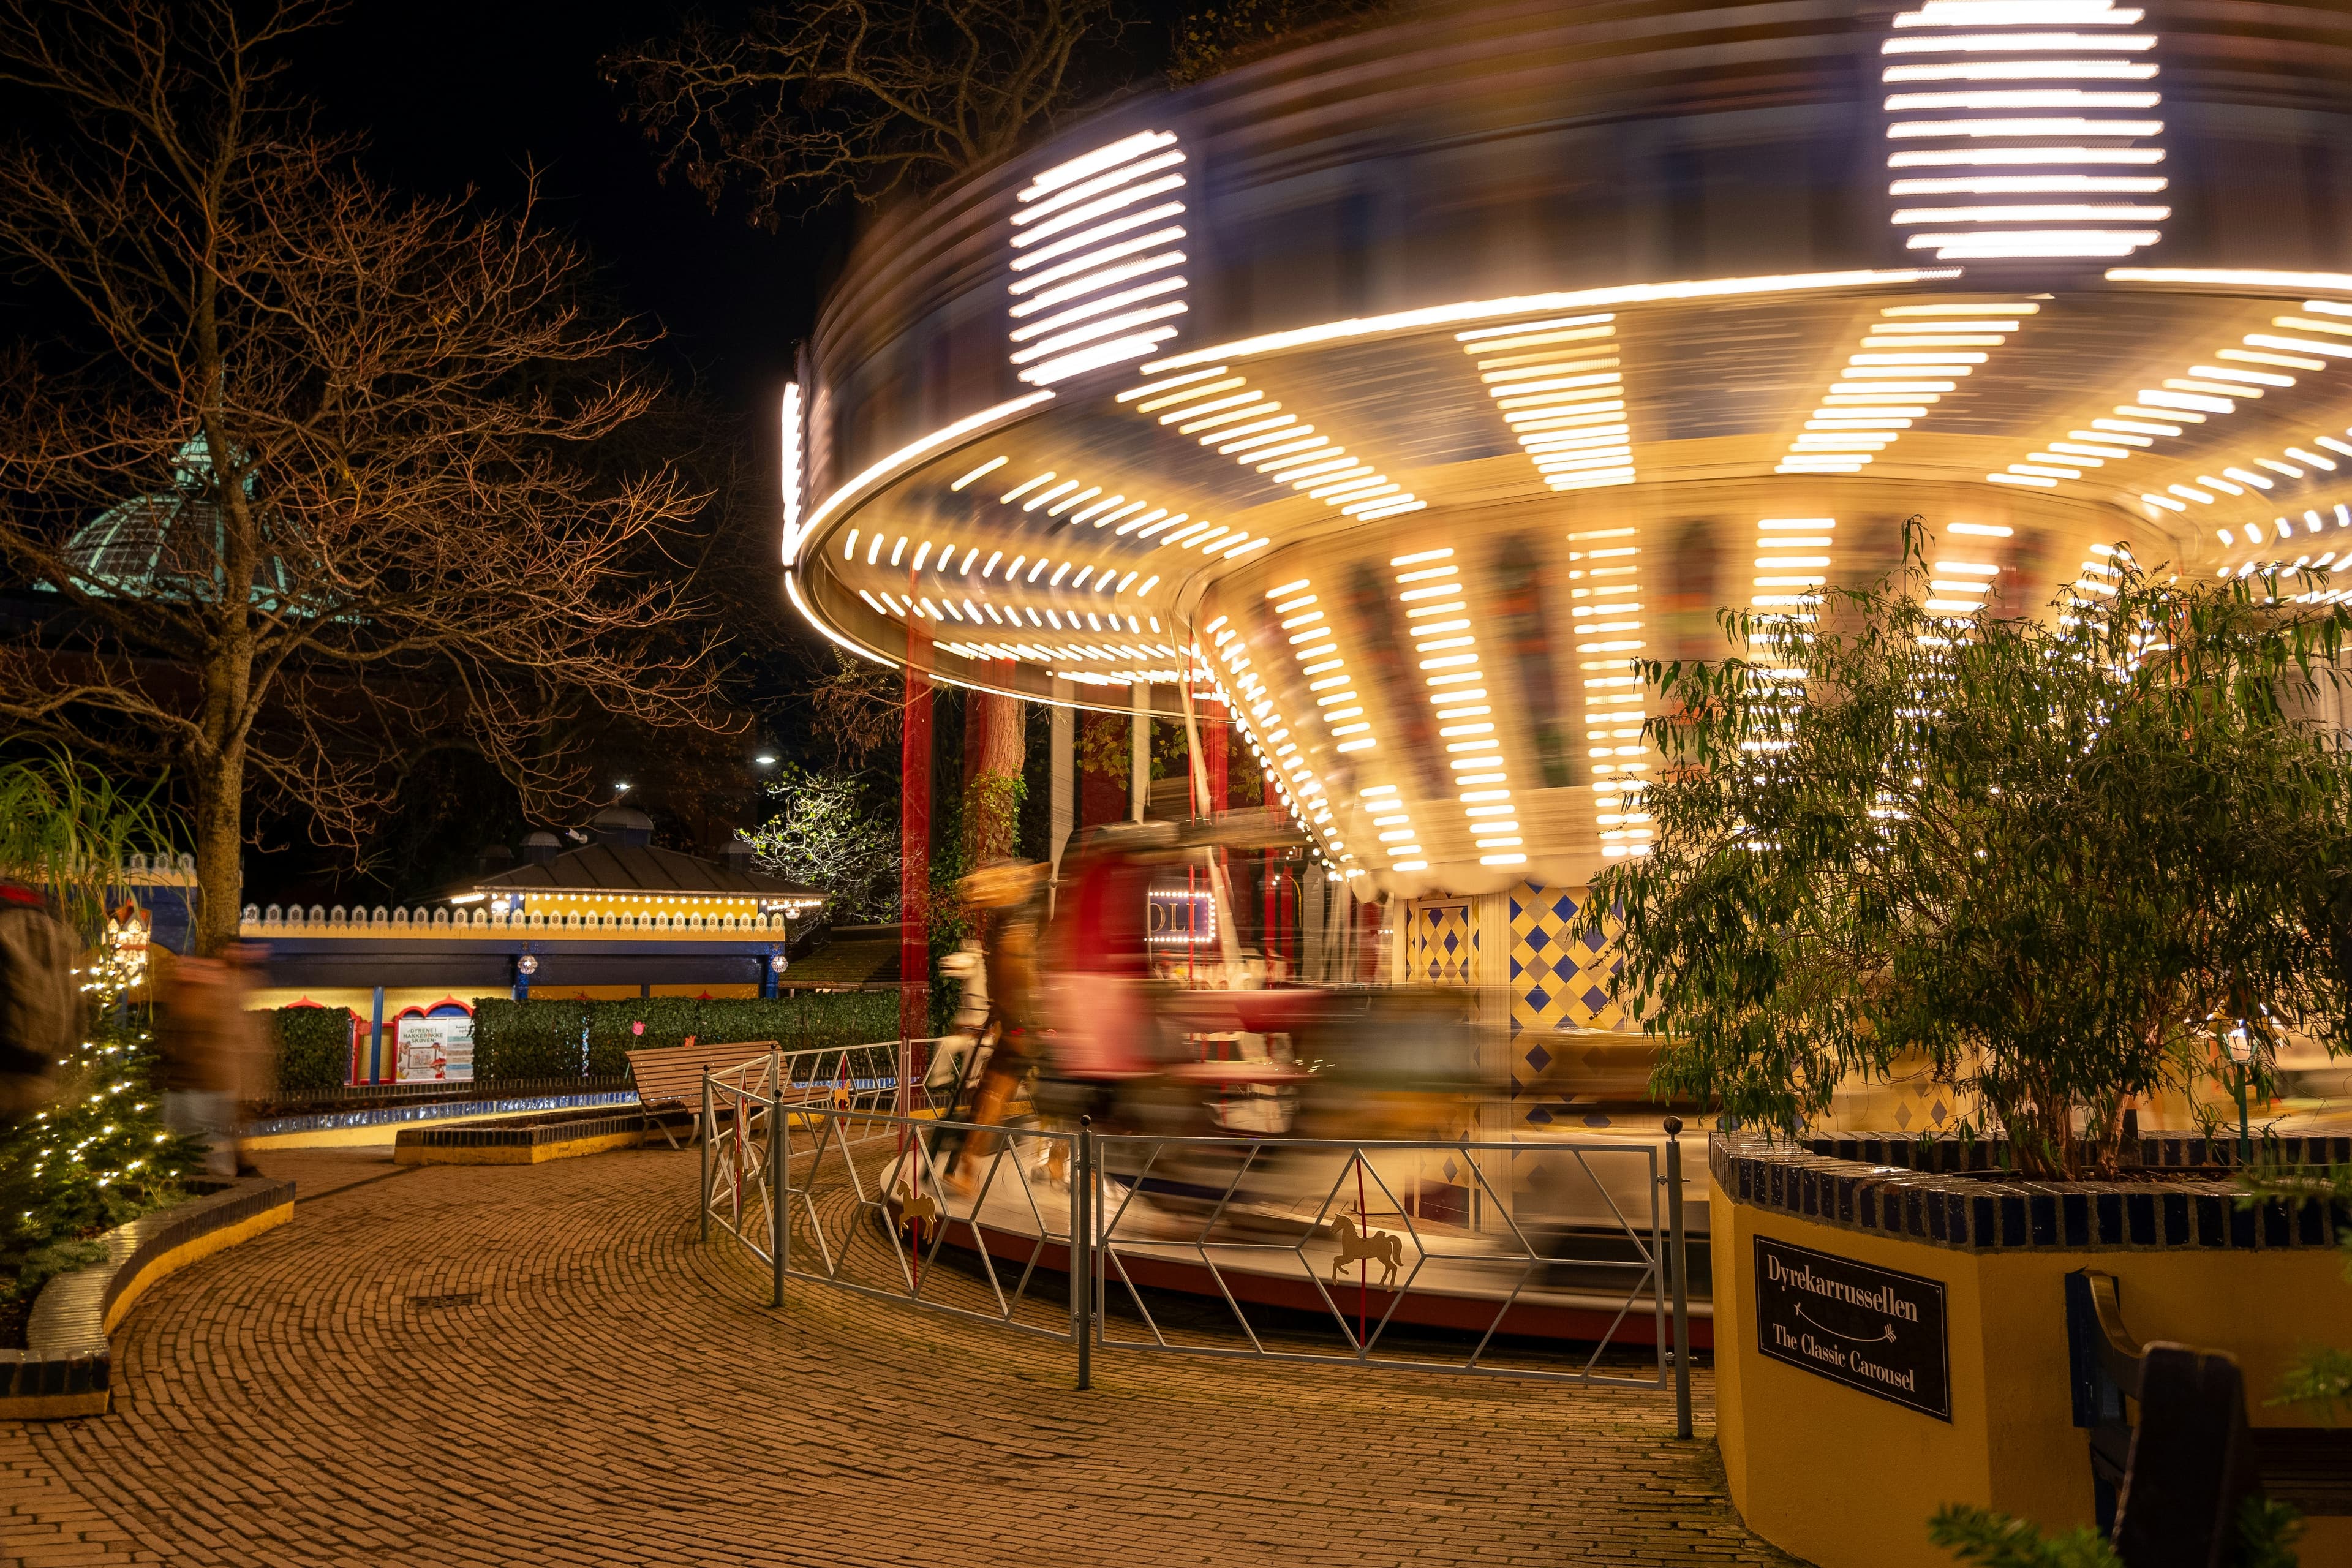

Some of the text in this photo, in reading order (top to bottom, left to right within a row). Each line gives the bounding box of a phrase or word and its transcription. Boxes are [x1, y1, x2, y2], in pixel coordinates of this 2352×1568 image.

[1768, 1254, 1919, 1322] Dyrekarrussellen
[1773, 1323, 1915, 1392] The Classic Carousel
